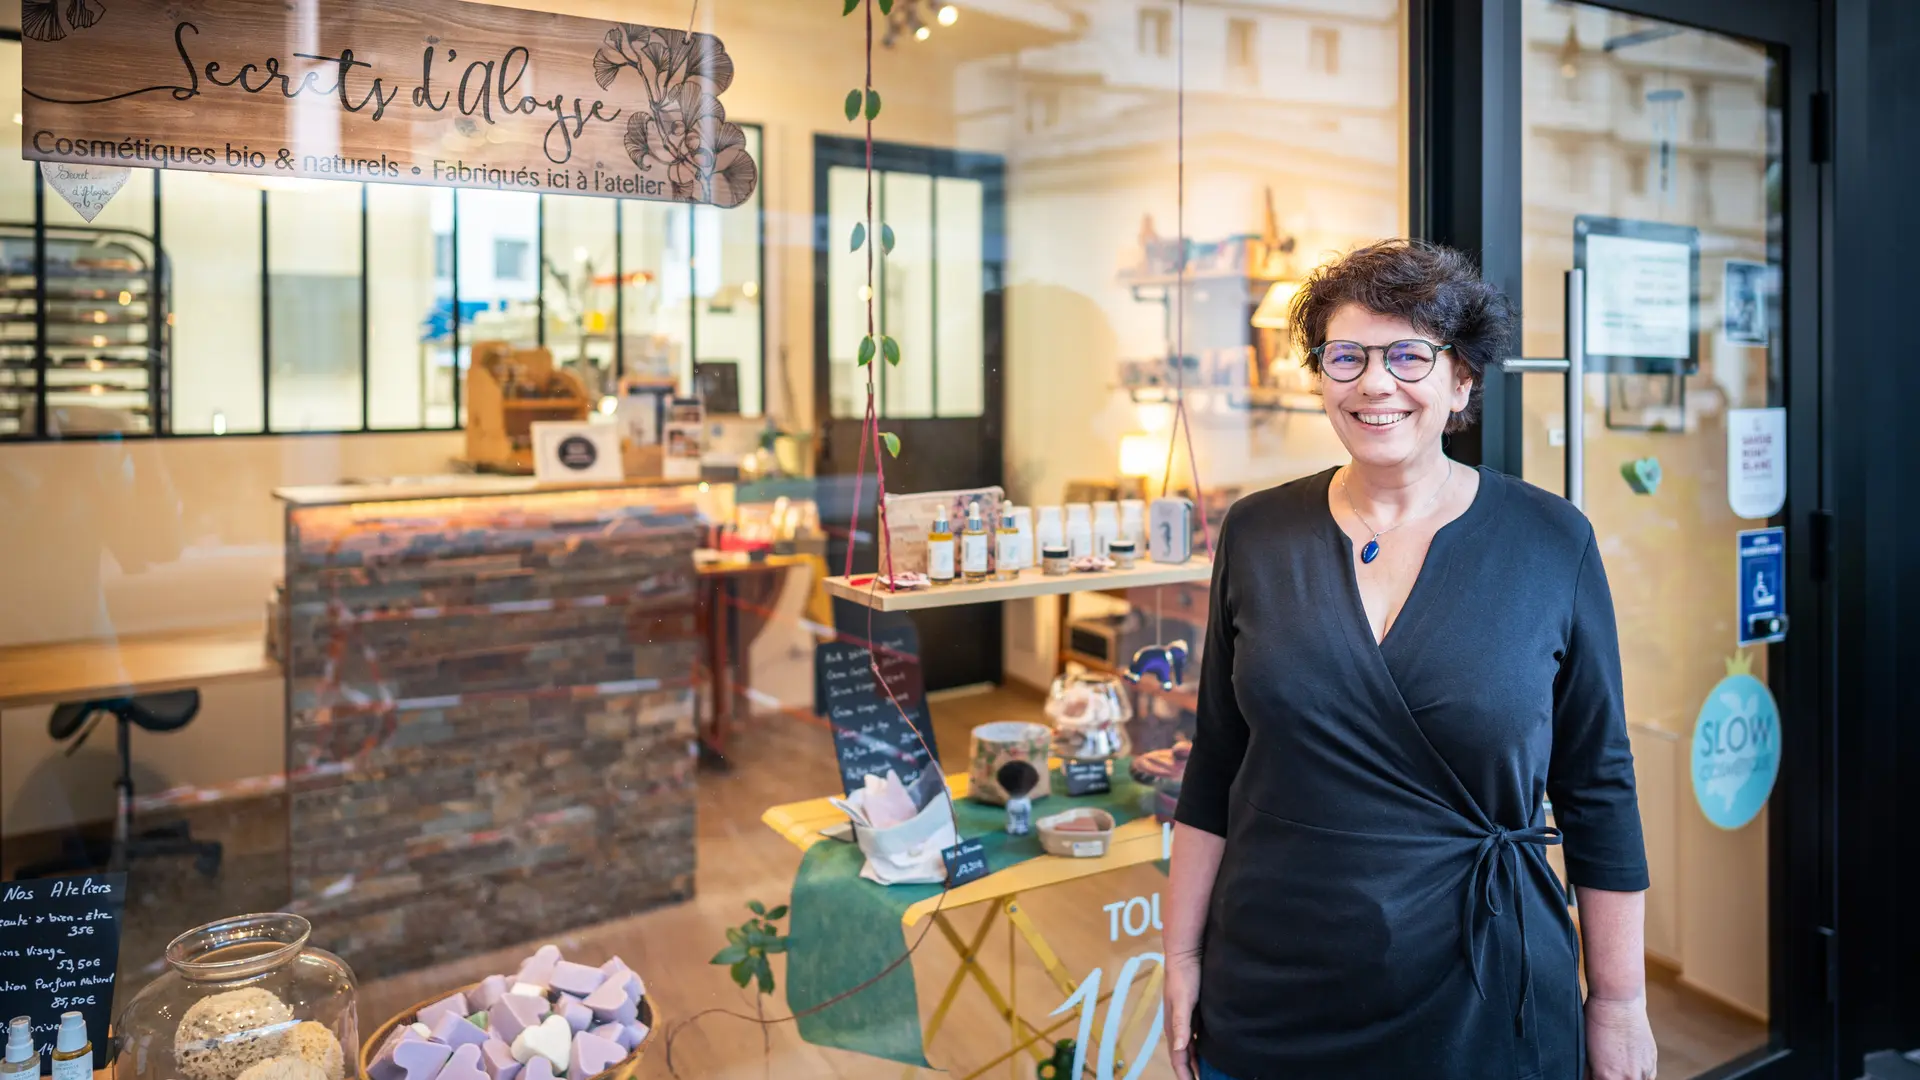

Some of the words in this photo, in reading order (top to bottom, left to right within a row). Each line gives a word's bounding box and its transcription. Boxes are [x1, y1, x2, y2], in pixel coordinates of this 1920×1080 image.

[171, 21, 399, 122] Secrets
[412, 45, 622, 164] d'Aloyse
[32, 130, 216, 169] Cosmétiques
[225, 143, 266, 169] bio
[274, 148, 295, 171] &
[303, 153, 399, 178] naturels
[432, 159, 540, 189] Fabriqués
[547, 168, 570, 189] ici
[576, 170, 588, 191] à
[595, 170, 666, 196] l'atelier
[1700, 714, 1774, 758] SLOW
[3, 885, 34, 902] Nos
[50, 877, 113, 898] Ateliers
[67, 926, 95, 937] 35€
[26, 945, 66, 961] Visage
[56, 958, 101, 973] 59,50€
[35, 977, 76, 993] Parfum
[51, 995, 97, 1009] 85,50€
